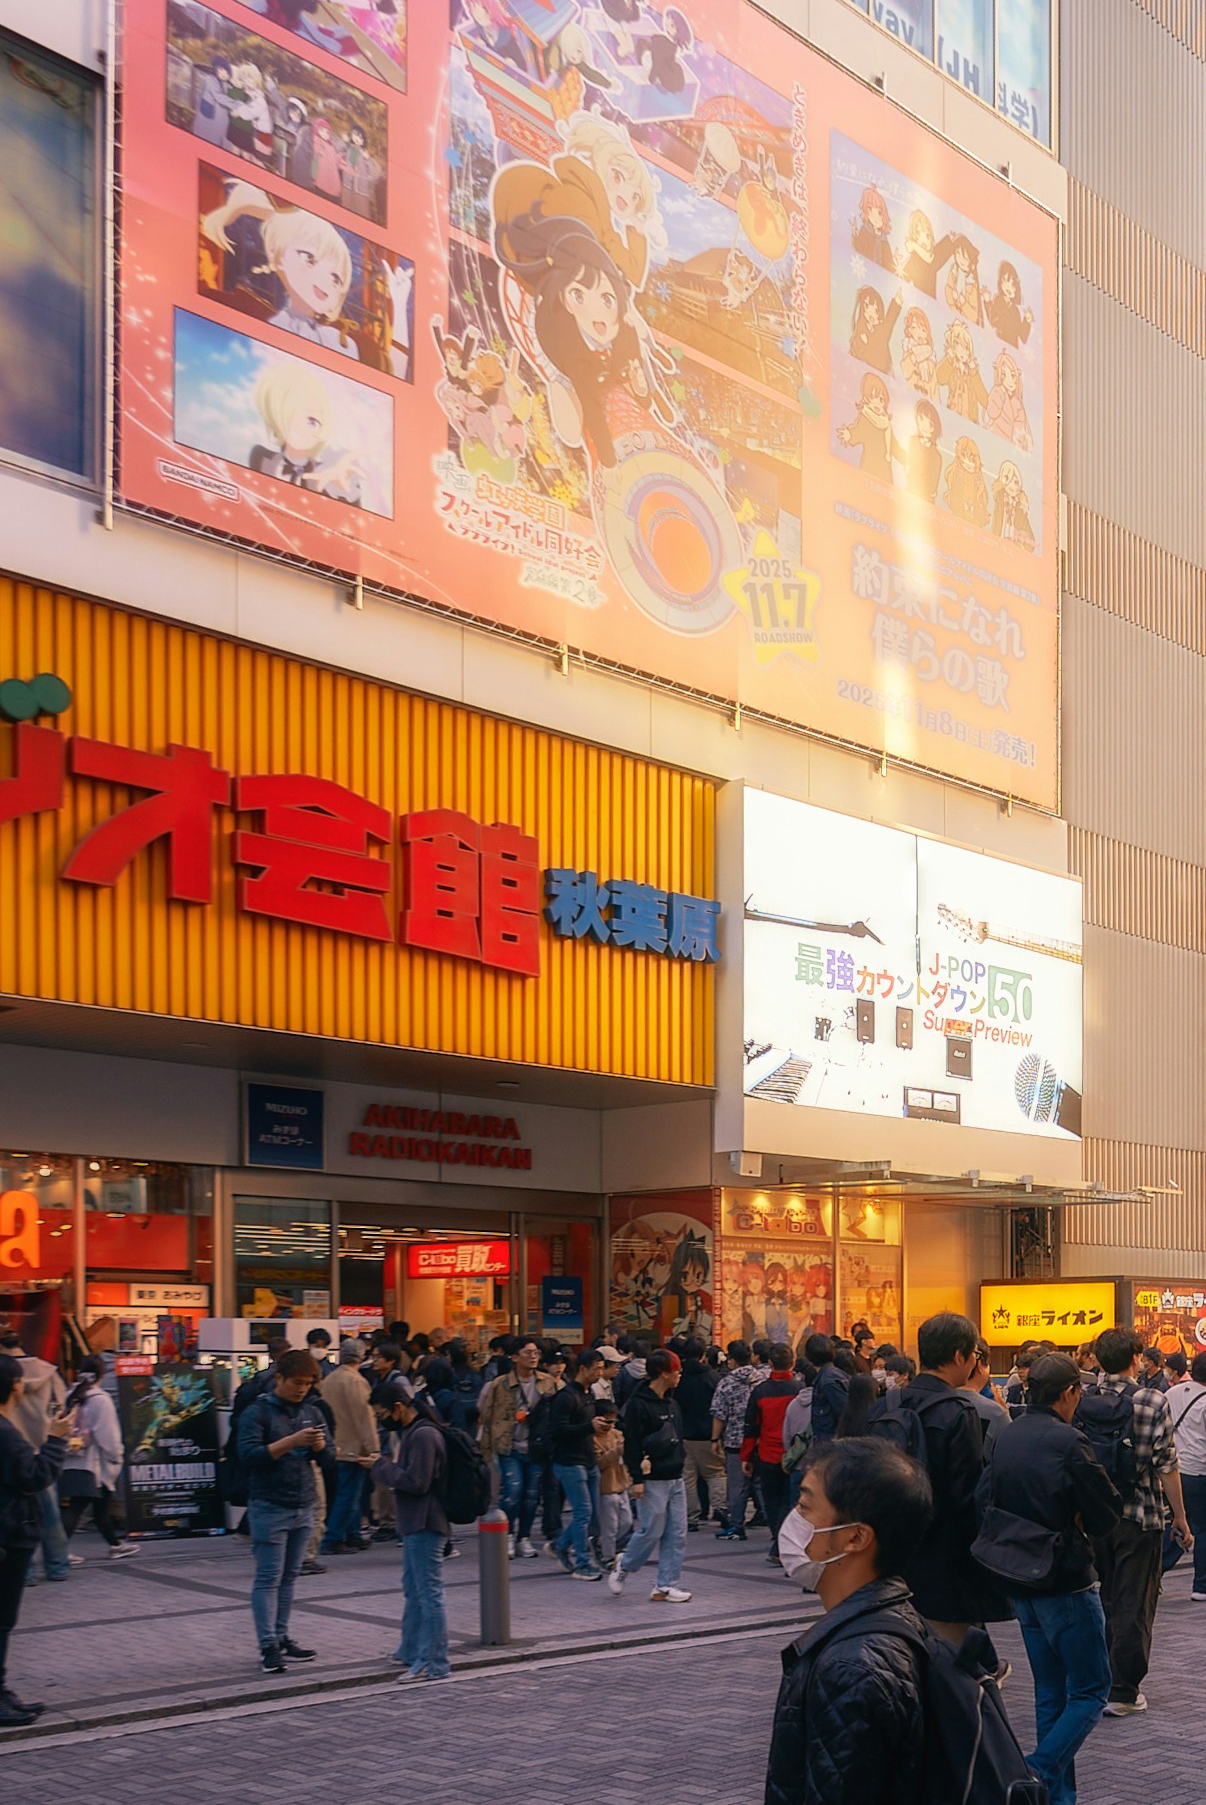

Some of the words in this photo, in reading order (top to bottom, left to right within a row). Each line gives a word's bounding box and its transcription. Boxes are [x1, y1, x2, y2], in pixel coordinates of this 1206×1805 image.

[742, 581, 808, 630] 11.7
[754, 631, 814, 645] ROADSHOW
[544, 868, 722, 964] 秋葉原
[794, 941, 987, 1015] 最強カウントダウン
[928, 952, 987, 985] J-POP
[973, 1019, 1034, 1048] Preview
[265, 1102, 308, 1116] MIZUHO
[361, 1103, 522, 1141] AKIHABARA
[349, 1131, 533, 1171] RADIOKAIKAN
[1016, 1309, 1104, 1327] 銀座ライオン
